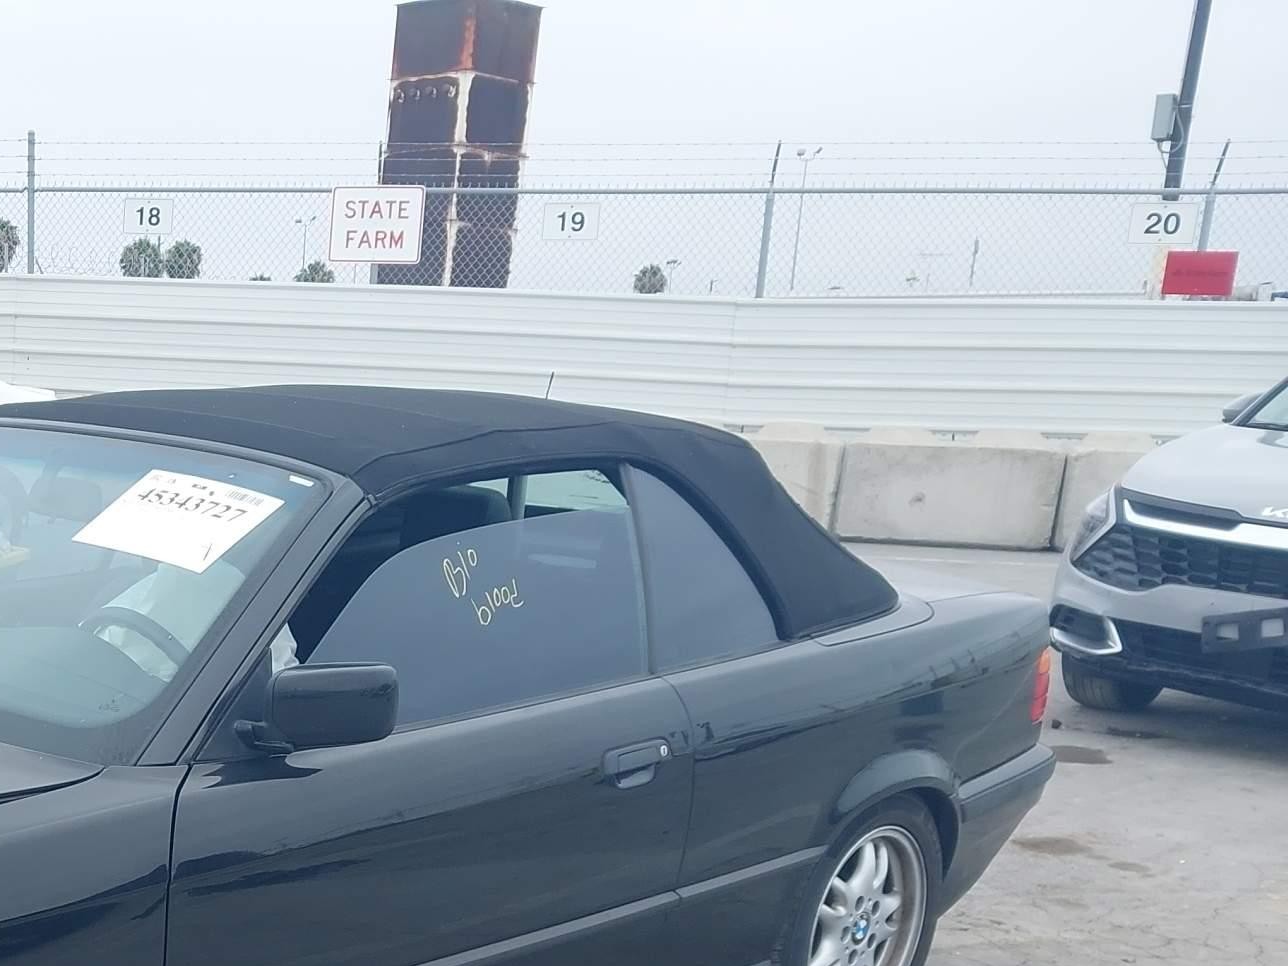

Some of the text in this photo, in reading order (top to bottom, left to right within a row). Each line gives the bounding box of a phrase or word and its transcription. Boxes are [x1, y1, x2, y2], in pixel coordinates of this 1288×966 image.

[135, 206, 161, 227] 18
[344, 199, 411, 220] STATE
[556, 211, 585, 232] 19
[1143, 212, 1181, 235] 20
[344, 229, 405, 249] FARM
[136, 487, 249, 523] 45343727
